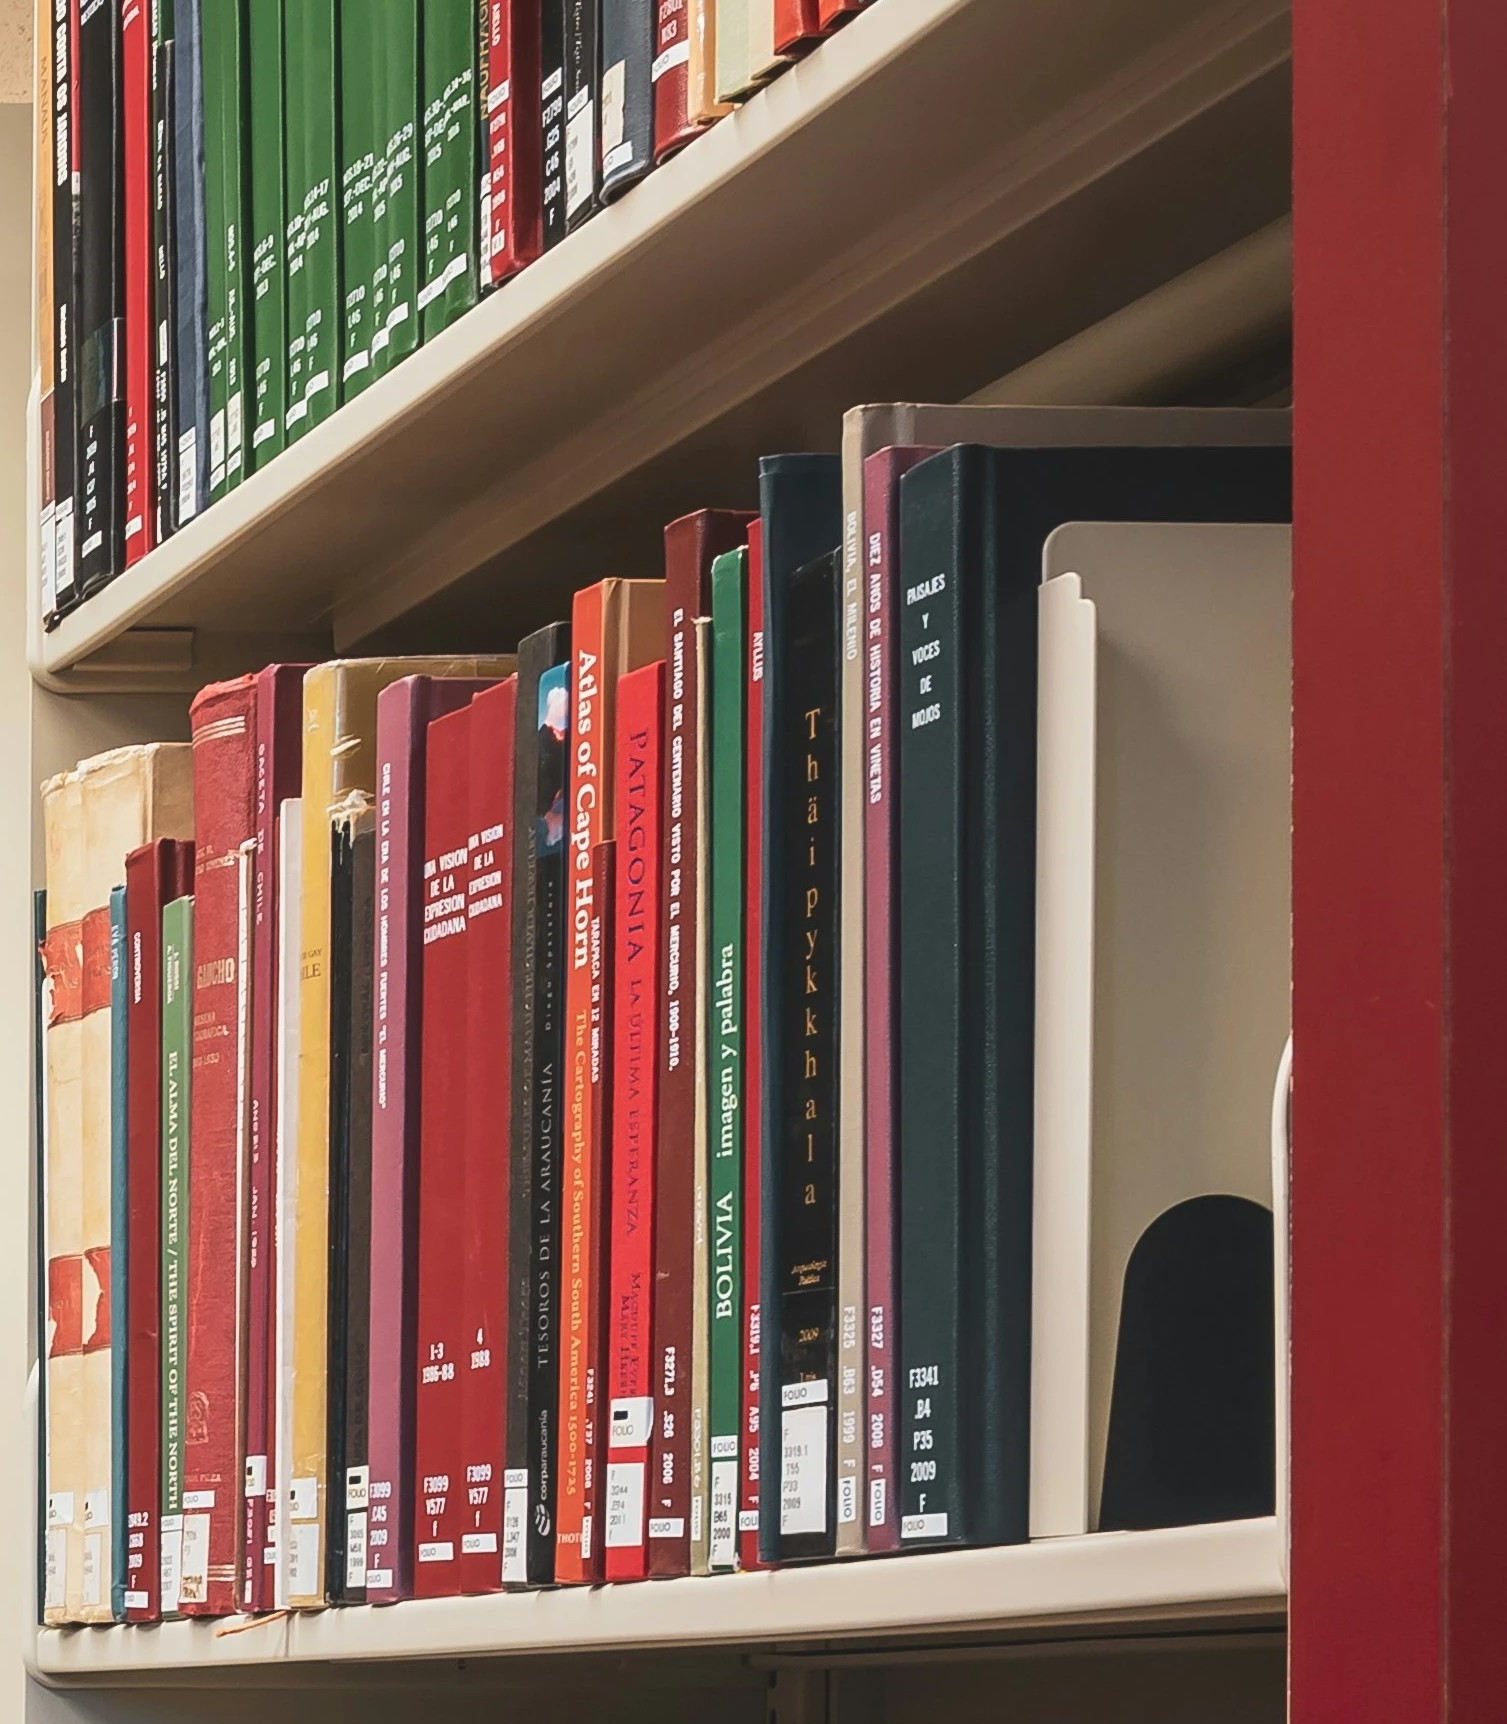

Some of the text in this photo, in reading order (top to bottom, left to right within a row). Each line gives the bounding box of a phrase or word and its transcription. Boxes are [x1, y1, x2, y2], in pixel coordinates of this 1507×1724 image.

[870, 533, 880, 566] DIEZ
[907, 575, 945, 605] PAISAJES
[922, 614, 929, 629] Y
[912, 641, 940, 664] VOCES
[870, 644, 880, 712] HISTORIA
[920, 676, 932, 694] DE
[673, 705, 682, 730] DEL
[912, 703, 940, 729] MOJOS
[571, 649, 598, 969] Atlas of Cape Horn
[627, 730, 648, 963] PATAGONIA
[671, 823, 681, 864] VISTO
[670, 869, 680, 896] POR
[168, 1077, 177, 1138] ALMA
[716, 943, 737, 1319] BOLIVIA imagen y palabra
[168, 1140, 177, 1174] DEL
[168, 1179, 177, 1242] NORTE
[169, 1260, 177, 1287] THE
[169, 1304, 177, 1364] SPIRIT
[909, 1367, 939, 1387] F3341
[169, 1398, 177, 1437] THE
[913, 1430, 933, 1451] P35
[169, 1446, 177, 1509] NORTH
[911, 1462, 936, 1482] 2009
